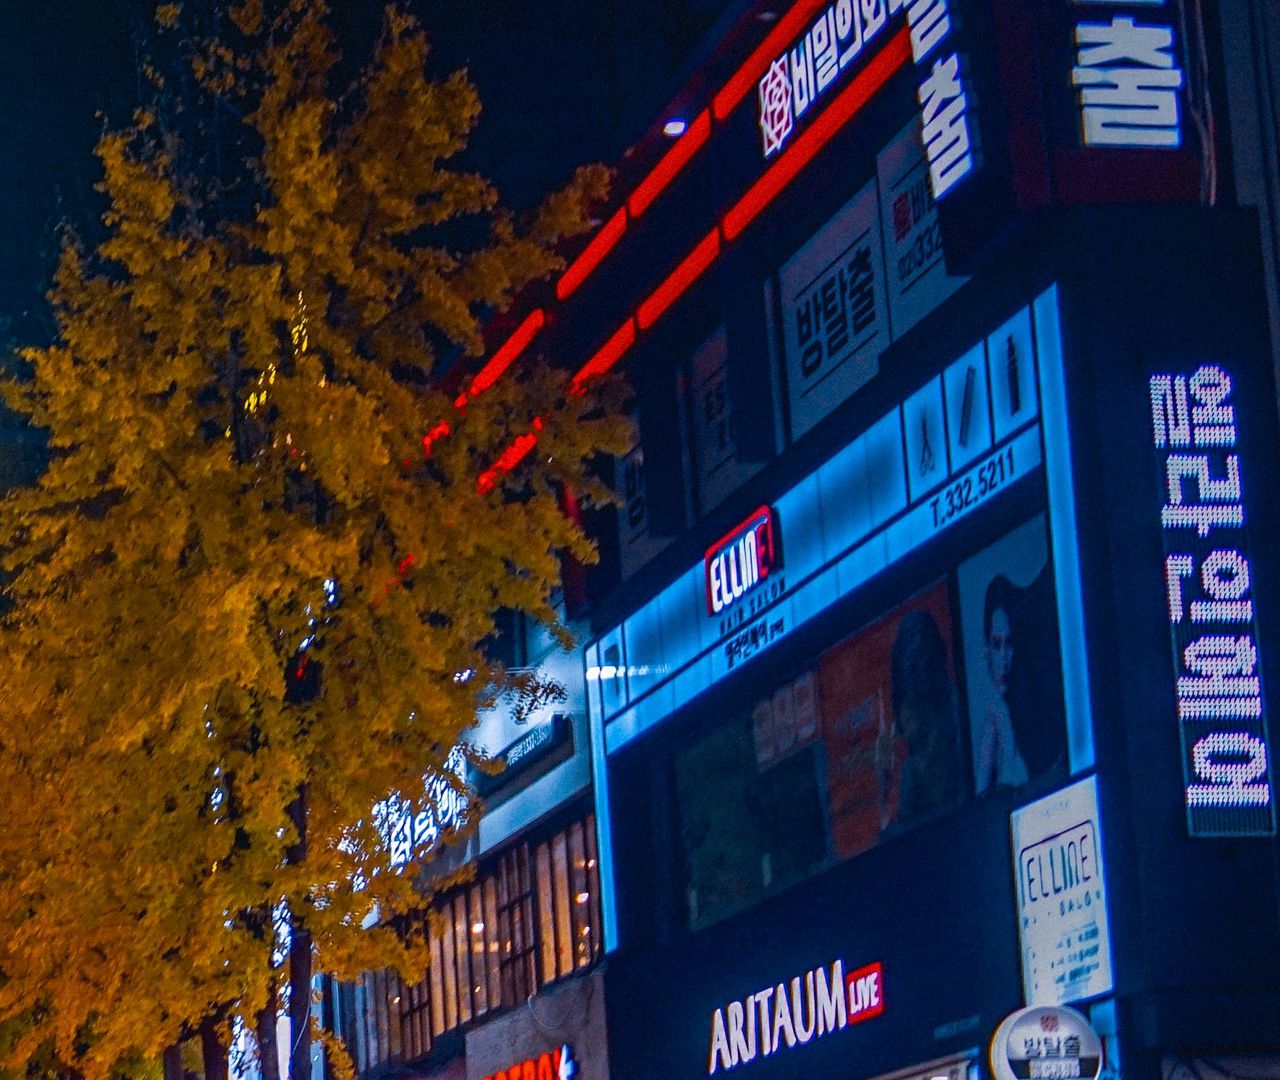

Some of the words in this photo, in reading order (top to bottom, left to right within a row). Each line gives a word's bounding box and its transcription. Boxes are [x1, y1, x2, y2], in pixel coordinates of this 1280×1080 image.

[791, 0, 904, 119] 비밀의
[1067, 0, 1182, 146] 출
[797, 247, 876, 378] 방탈출
[930, 446, 1014, 528] T.332.5211
[710, 523, 769, 613] ELLINE
[1149, 365, 1270, 808] 엘라인헤어
[1026, 833, 1091, 902] ELLINE
[709, 959, 847, 1075] ARITAUM
[849, 972, 879, 1015] LIVE
